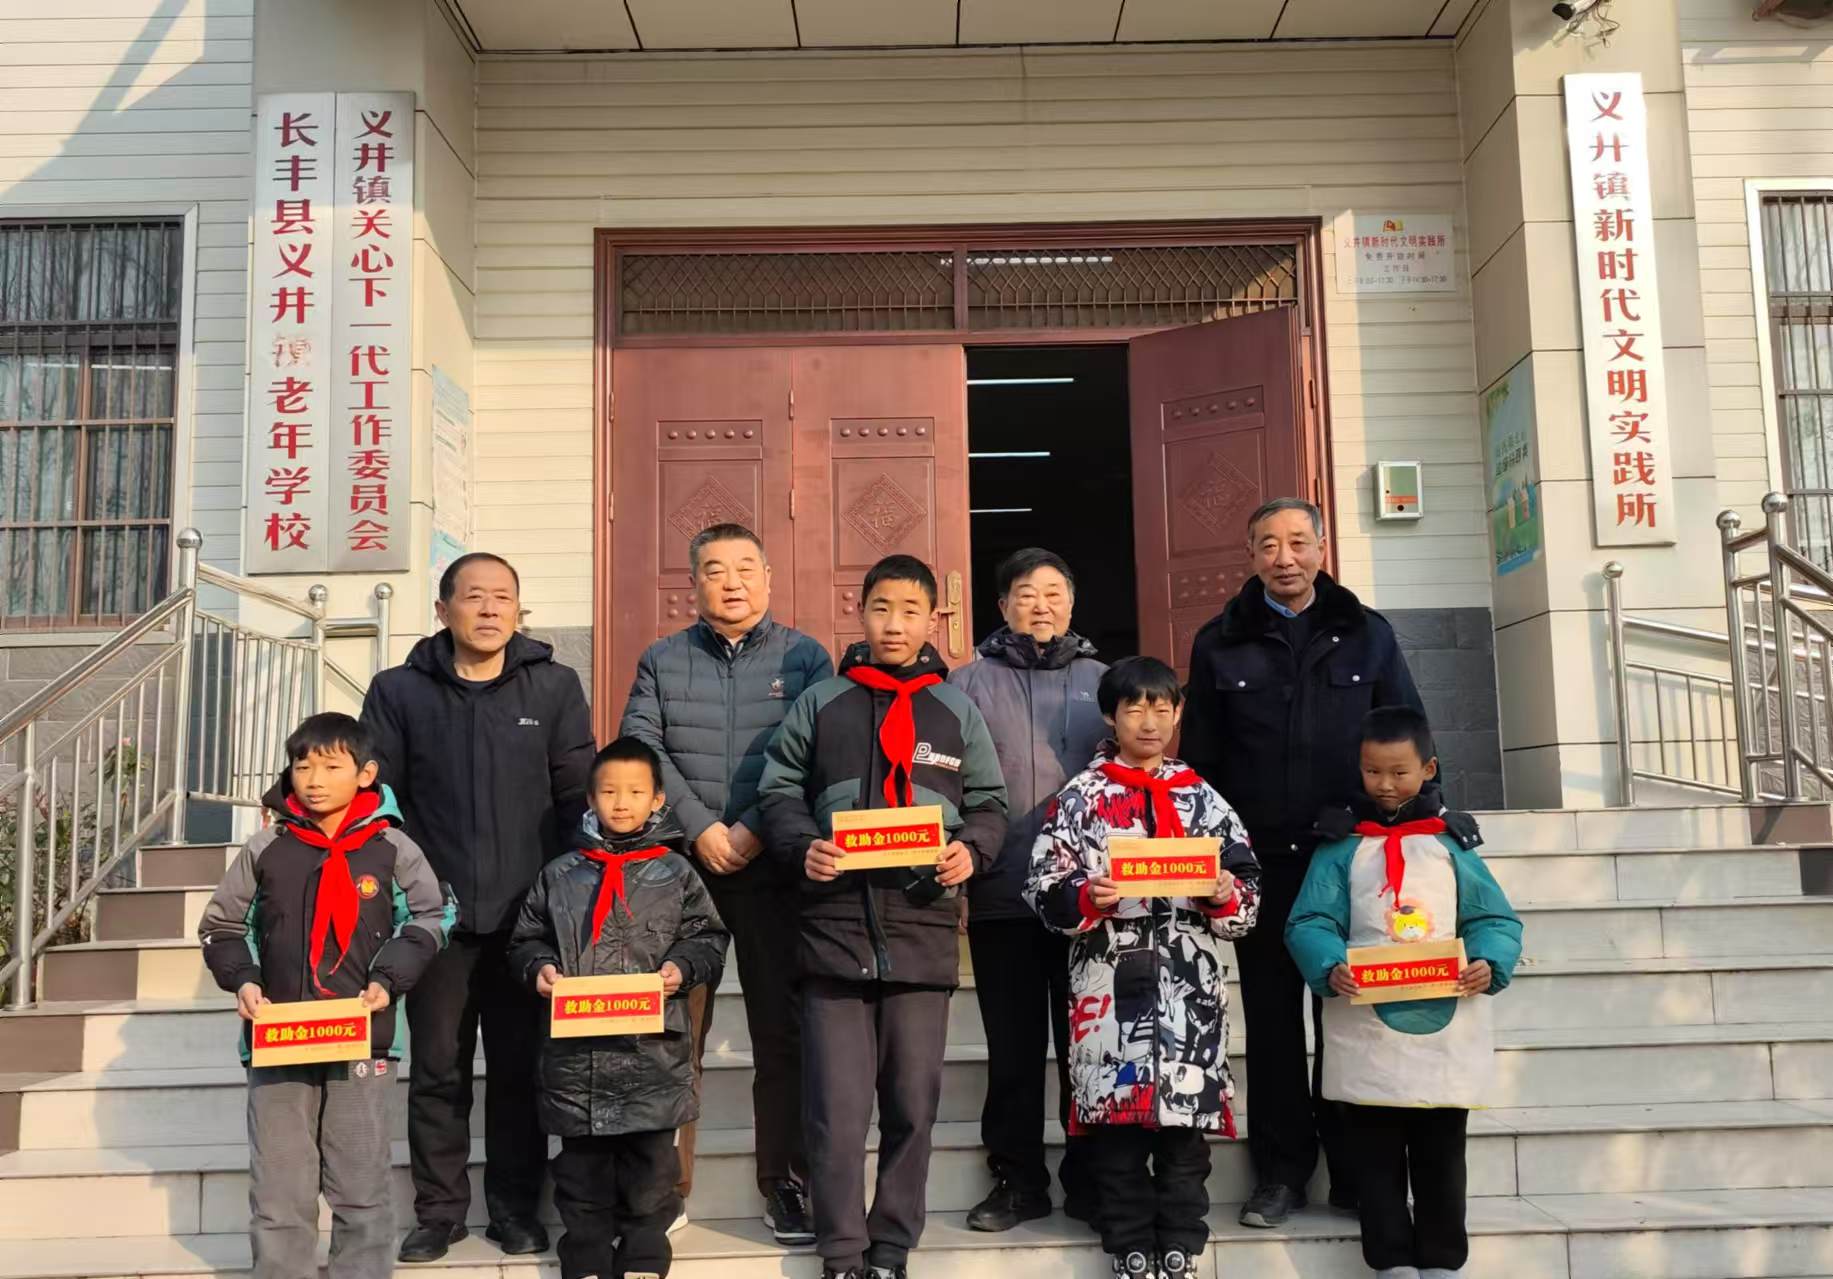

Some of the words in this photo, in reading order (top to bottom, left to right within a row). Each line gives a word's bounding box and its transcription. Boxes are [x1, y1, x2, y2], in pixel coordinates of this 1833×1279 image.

[1588, 88, 1657, 528] 义井镇新时代文明实践所
[346, 110, 395, 551] 义井镇关心下一代工作委员会
[845, 829, 931, 848] 救助金1000元
[1121, 861, 1207, 876] 救助金1000元
[1361, 964, 1449, 983] 救助金1000元
[564, 997, 651, 1015] 救助金1000元
[264, 1022, 356, 1042] 救助金1000元
